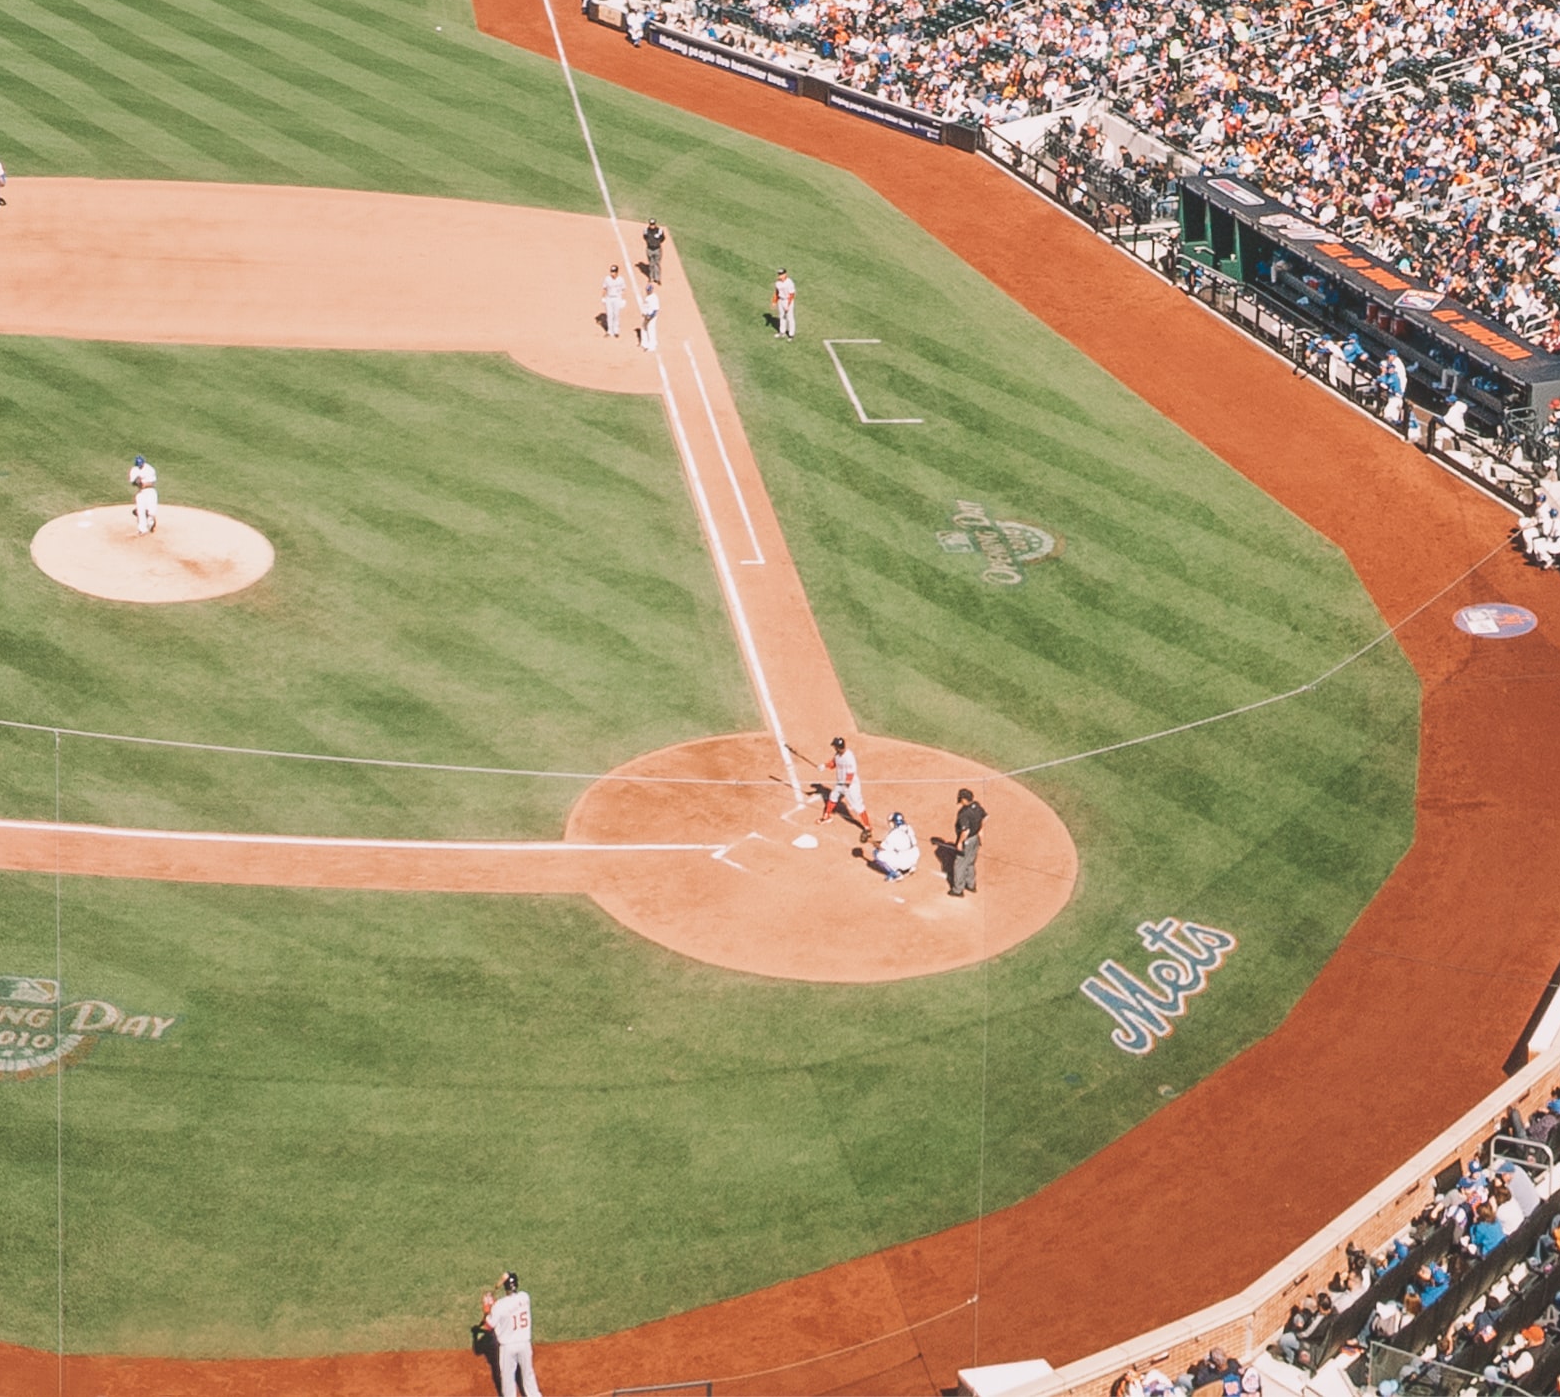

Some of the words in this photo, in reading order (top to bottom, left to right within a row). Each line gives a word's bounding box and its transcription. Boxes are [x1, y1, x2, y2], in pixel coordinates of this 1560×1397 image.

[1079, 917, 1237, 1056] Mets
[60, 1000, 176, 1040] DAY
[512, 1311, 529, 1331] 15
